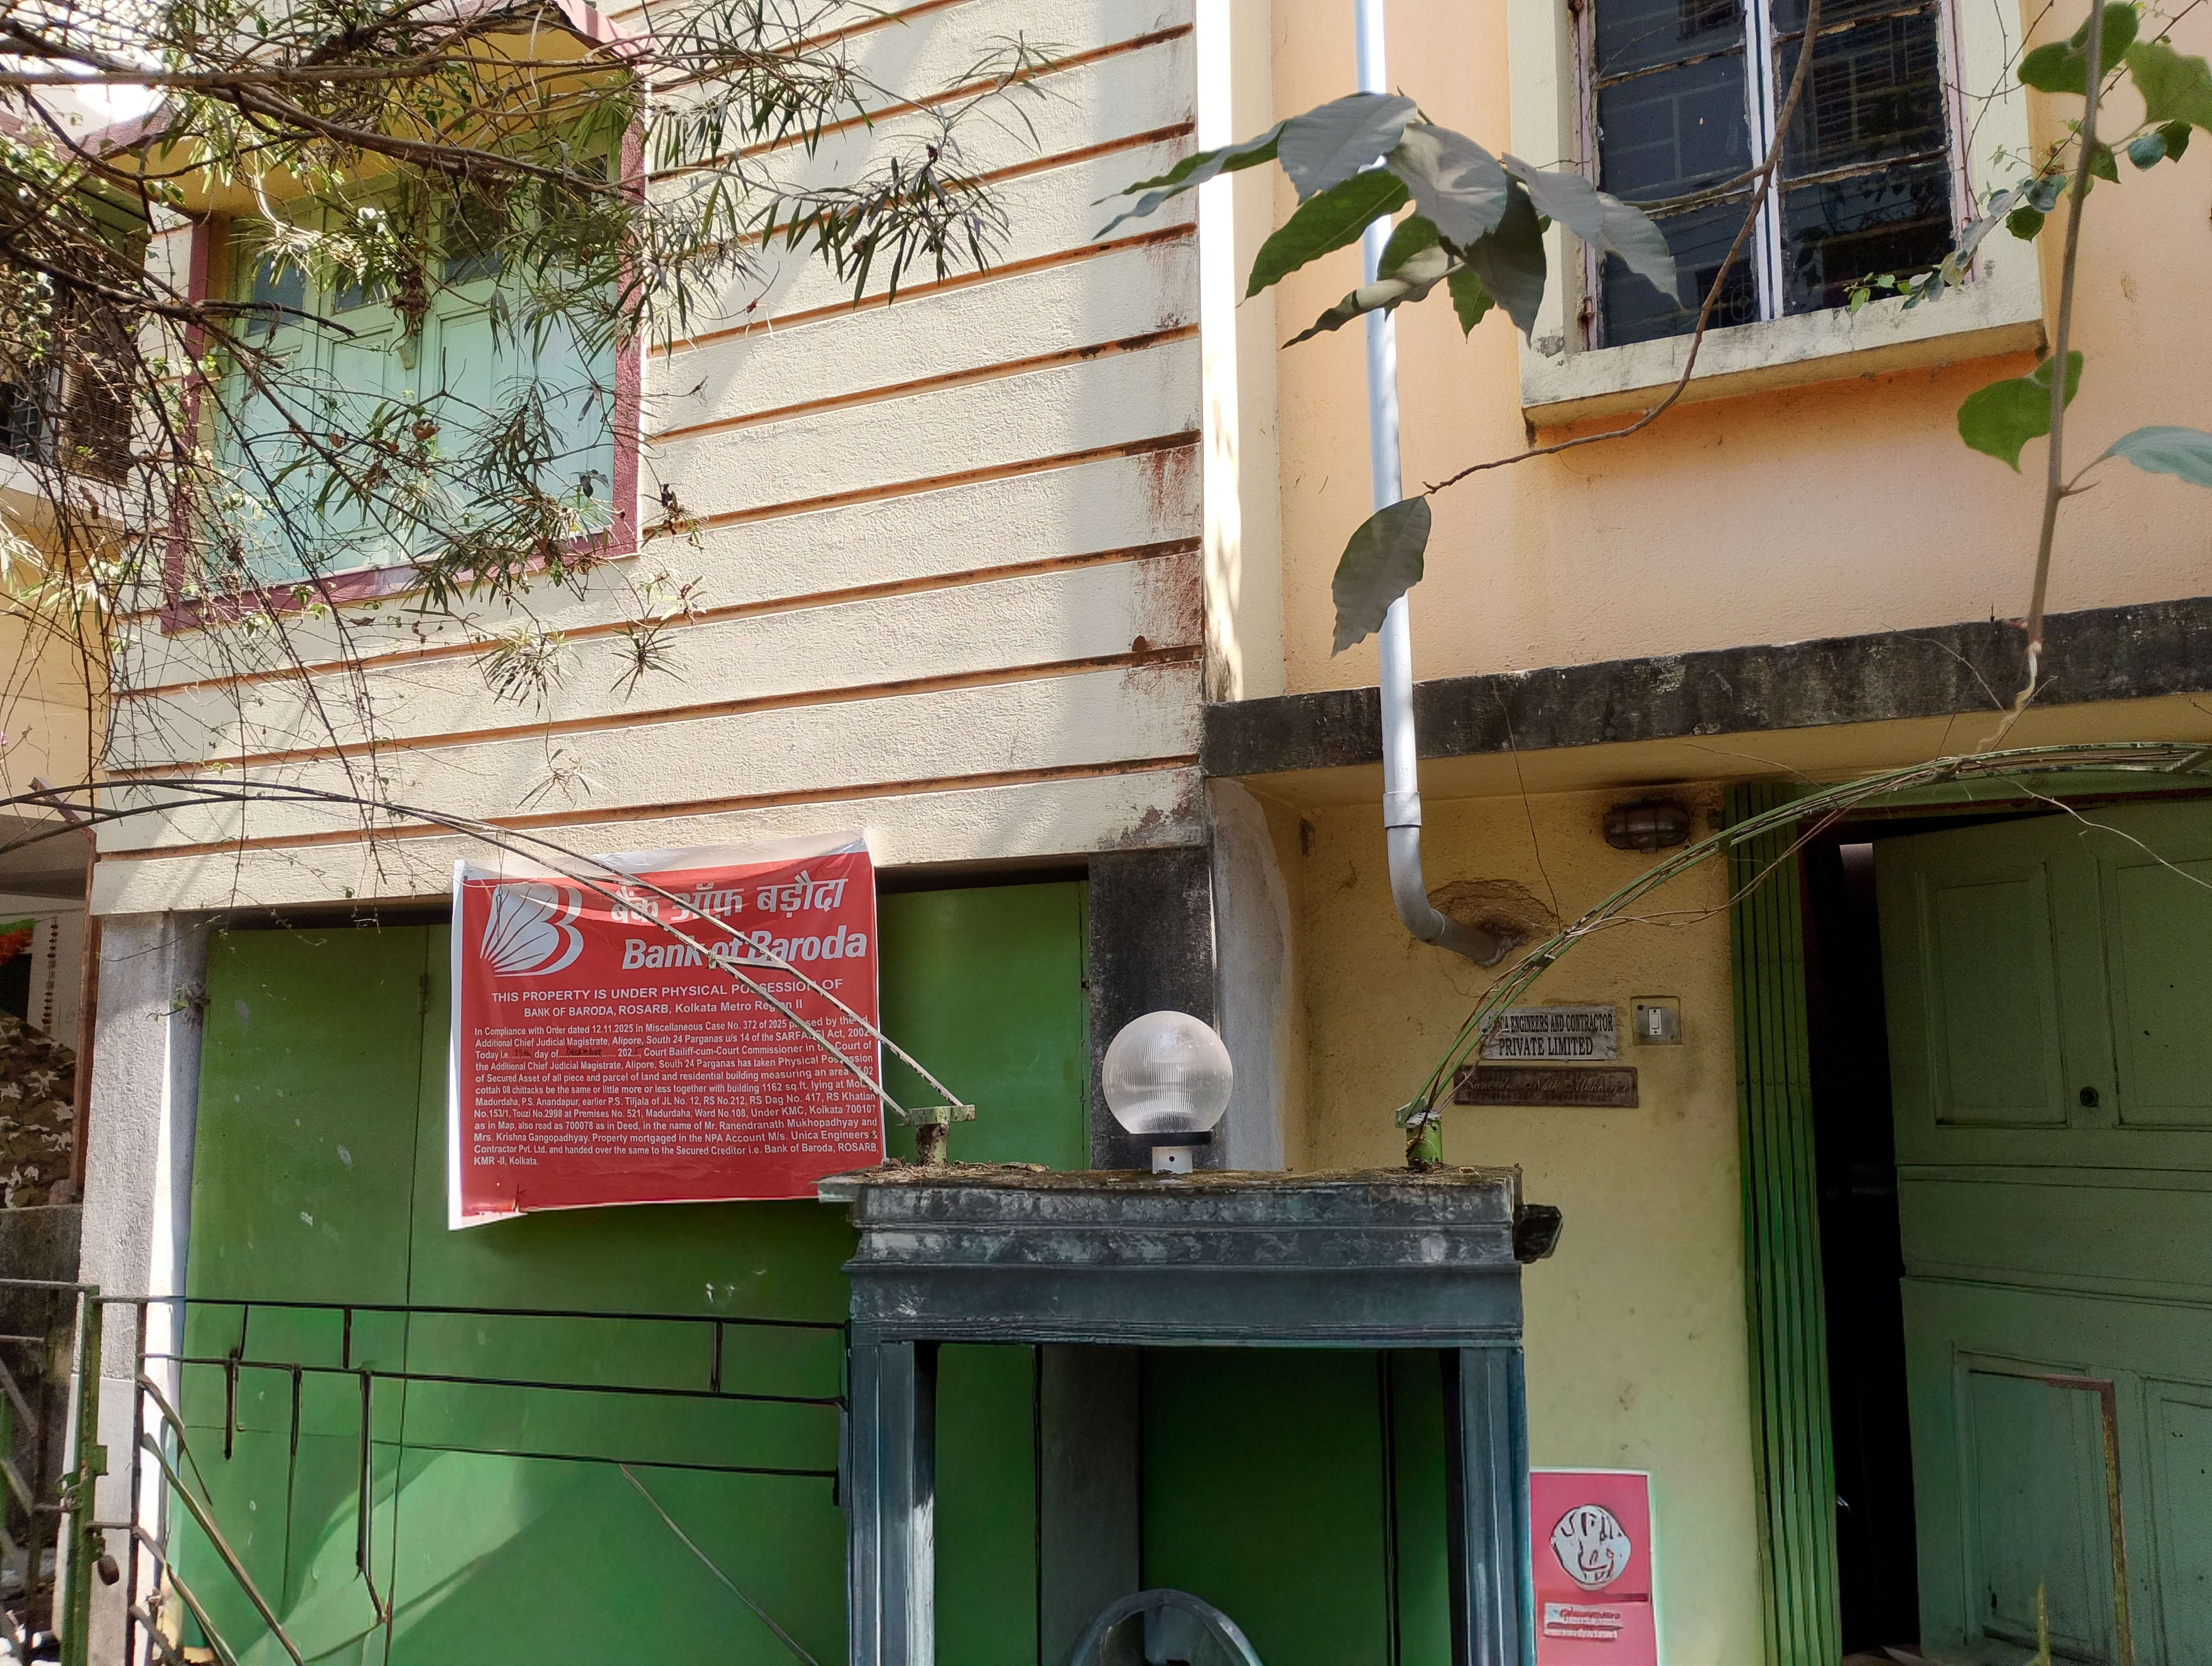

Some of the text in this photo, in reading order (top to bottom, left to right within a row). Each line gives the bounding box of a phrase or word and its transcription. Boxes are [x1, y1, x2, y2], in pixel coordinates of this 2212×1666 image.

[756, 869, 849, 918] बड़ौदा
[622, 934, 705, 970] Bank
[747, 924, 867, 962] Baroda
[491, 992, 518, 1002] THIS
[523, 990, 589, 1001] PROPERTY
[594, 989, 607, 999] IS
[611, 988, 658, 999] UNDER
[661, 985, 727, 997] PHYSICAL
[822, 978, 843, 989] OF
[524, 1007, 550, 1017] BANK
[552, 1007, 565, 1016] OF
[675, 1003, 717, 1013] Kolkata
[720, 1002, 751, 1011] Metro
[795, 998, 802, 1009] II
[474, 1027, 482, 1036] In
[484, 1027, 525, 1037] Compliance
[528, 1026, 544, 1035] with
[546, 1026, 565, 1034] Order
[567, 1025, 589, 1034] dated
[635, 1023, 643, 1033] in
[646, 1022, 703, 1031] Miscellaneous
[705, 1021, 725, 1030] Case
[743, 1020, 757, 1029] 372
[758, 1019, 767, 1029] of
[768, 1019, 787, 1028] 2025
[825, 1016, 837, 1027] by
[839, 1016, 853, 1025] the
[1510, 1015, 1548, 1033] ENGINEERS
[1550, 1014, 1564, 1033] AND
[1566, 1013, 1613, 1032] CONTRACTOR
[475, 1038, 512, 1048] Additional
[514, 1037, 534, 1047] Chief
[536, 1037, 565, 1047] Judicial
[646, 1035, 671, 1045] South
[673, 1034, 683, 1043] 24
[685, 1034, 723, 1045] Parganas
[725, 1033, 737, 1042] u/s
[740, 1033, 749, 1041] 14
[751, 1032, 760, 1041] of
[761, 1032, 774, 1041] the
[1499, 1036, 1593, 1056] PRIVATE LIMITED
[475, 1050, 498, 1061] Today
[535, 1049, 548, 1060] day
[550, 1049, 558, 1058] of
[644, 1047, 667, 1056] Court
[741, 1045, 803, 1054] Commissioner
[805, 1043, 815, 1052] in
[835, 1041, 861, 1051] Court
[863, 1040, 871, 1050] of
[475, 1062, 488, 1071] the
[491, 1062, 525, 1071] Additional
[528, 1061, 548, 1071] Chief
[550, 1061, 578, 1069] Judicial
[659, 1059, 683, 1068] South
[685, 1059, 694, 1067] 24
[697, 1059, 735, 1069] Parganas
[737, 1058, 751, 1067] has
[753, 1058, 775, 1067] taken
[778, 1055, 818, 1067] Physical
[486, 1073, 517, 1082] Secured
[518, 1073, 539, 1082] Asset
[552, 1073, 561, 1081] all
[563, 1073, 584, 1084] piece
[603, 1072, 628, 1084] parcel
[641, 1072, 659, 1080] land
[679, 1071, 723, 1080] residential
[725, 1070, 758, 1081] building
[761, 1068, 811, 1079] measuring
[475, 1085, 500, 1094] cottah
[502, 1085, 510, 1093] 08
[512, 1085, 543, 1094] chittacks
[602, 1085, 619, 1093] little
[655, 1084, 671, 1093] less
[673, 1084, 706, 1094] together
[709, 1083, 725, 1092] with
[726, 1083, 759, 1094] building
[762, 1082, 782, 1091] 1162
[811, 1080, 833, 1091] lying
[582, 1097, 606, 1105] earlier
[661, 1096, 672, 1105] JL
[703, 1095, 715, 1105] RS
[749, 1095, 762, 1104] RS
[764, 1095, 783, 1105] Dag
[826, 1092, 839, 1101] RS
[512, 1108, 531, 1117] Touzi
[574, 1108, 609, 1117] Premises
[695, 1108, 715, 1117] Ward
[751, 1107, 779, 1117] Under
[809, 1105, 843, 1114] Kolkata
[845, 1104, 875, 1114] 700107
[518, 1121, 533, 1129] also
[535, 1121, 551, 1129] read
[565, 1121, 593, 1129] 700078
[719, 1119, 783, 1130] Ranendranath
[787, 1117, 859, 1129] Mukhopadhyay
[496, 1132, 526, 1141] Krishna
[592, 1133, 627, 1144] Property
[629, 1133, 676, 1144] mortgaged
[704, 1133, 723, 1142] NPA
[725, 1133, 765, 1142] Account
[791, 1130, 818, 1140] Unica
[821, 1130, 869, 1141] Engineers
[474, 1144, 517, 1153] Contractor
[564, 1145, 593, 1154] handed
[676, 1145, 709, 1155] Secured
[711, 1145, 745, 1155] Creditor
[764, 1144, 787, 1153] Bank
[474, 1156, 495, 1165] KMR
